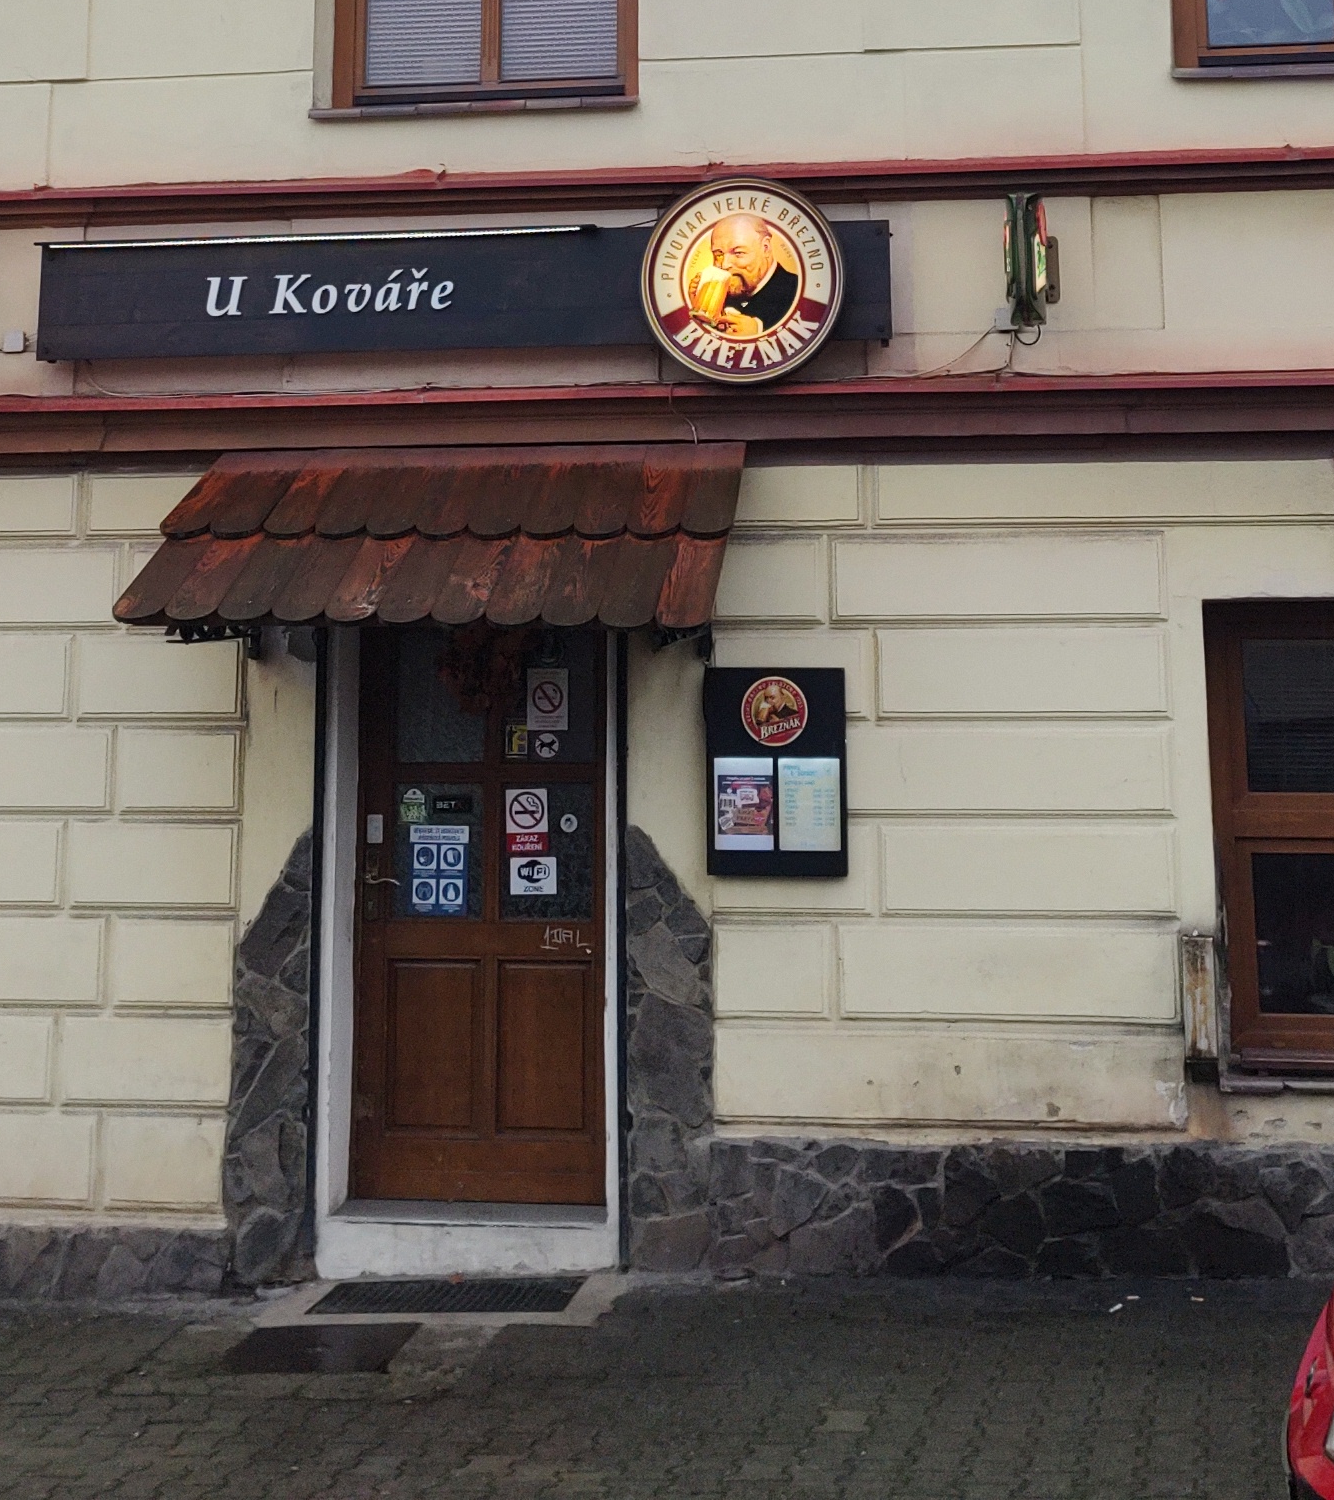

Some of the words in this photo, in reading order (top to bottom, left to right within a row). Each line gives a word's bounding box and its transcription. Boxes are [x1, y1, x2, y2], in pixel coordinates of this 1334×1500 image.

[661, 211, 707, 282] PIVOVAR
[713, 197, 771, 215] VELKÉ
[776, 208, 824, 271] BŘEZNO
[206, 276, 248, 317] U
[268, 268, 454, 314] Kováře
[516, 834, 539, 842] ZÁKAZ
[523, 885, 544, 893] ZONE
